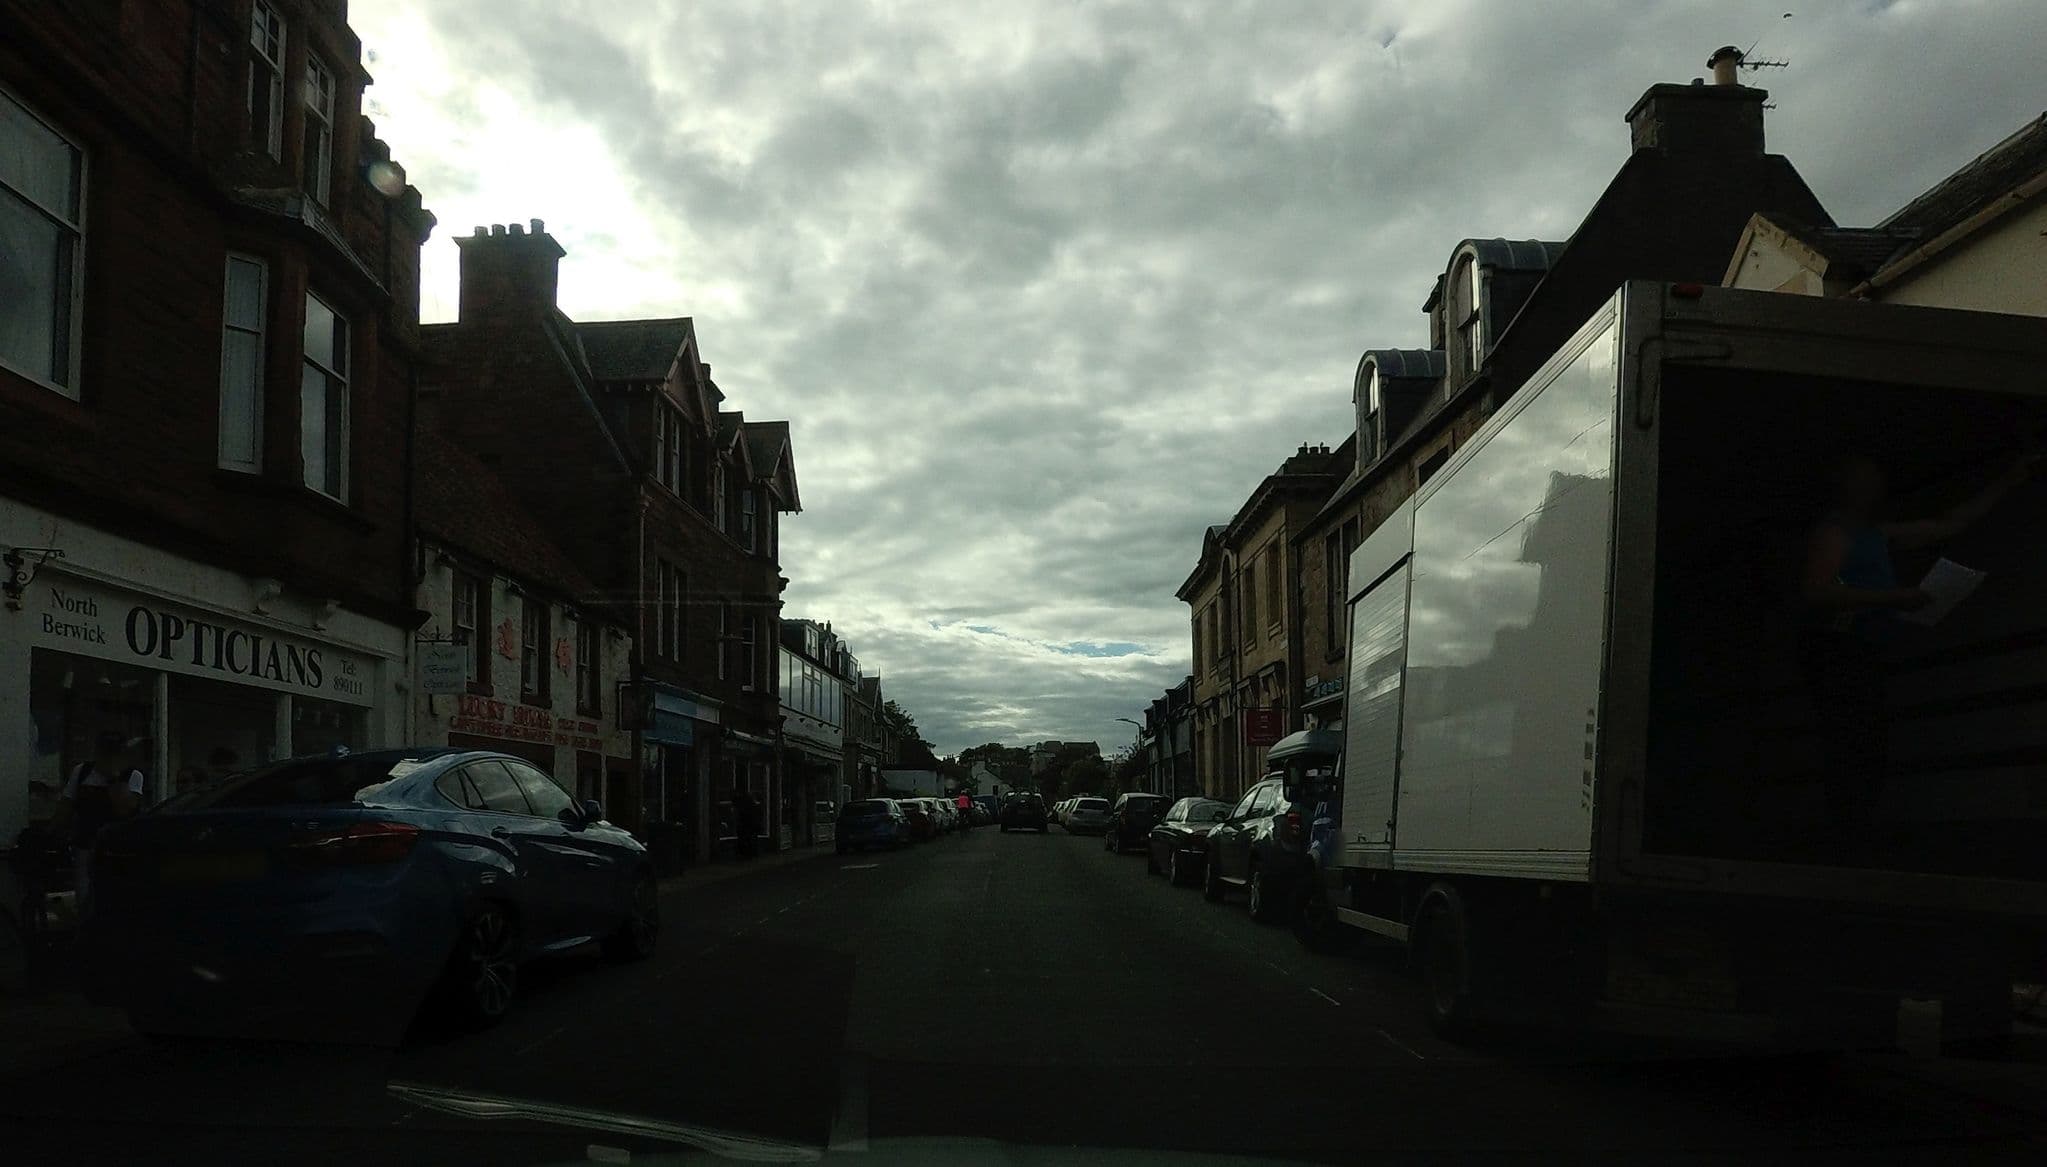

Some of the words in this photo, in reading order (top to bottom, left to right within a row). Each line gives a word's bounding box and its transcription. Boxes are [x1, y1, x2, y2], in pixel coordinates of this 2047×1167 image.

[50, 588, 98, 618] North
[42, 613, 106, 645] Berwick
[126, 606, 323, 689] OPTICIANS
